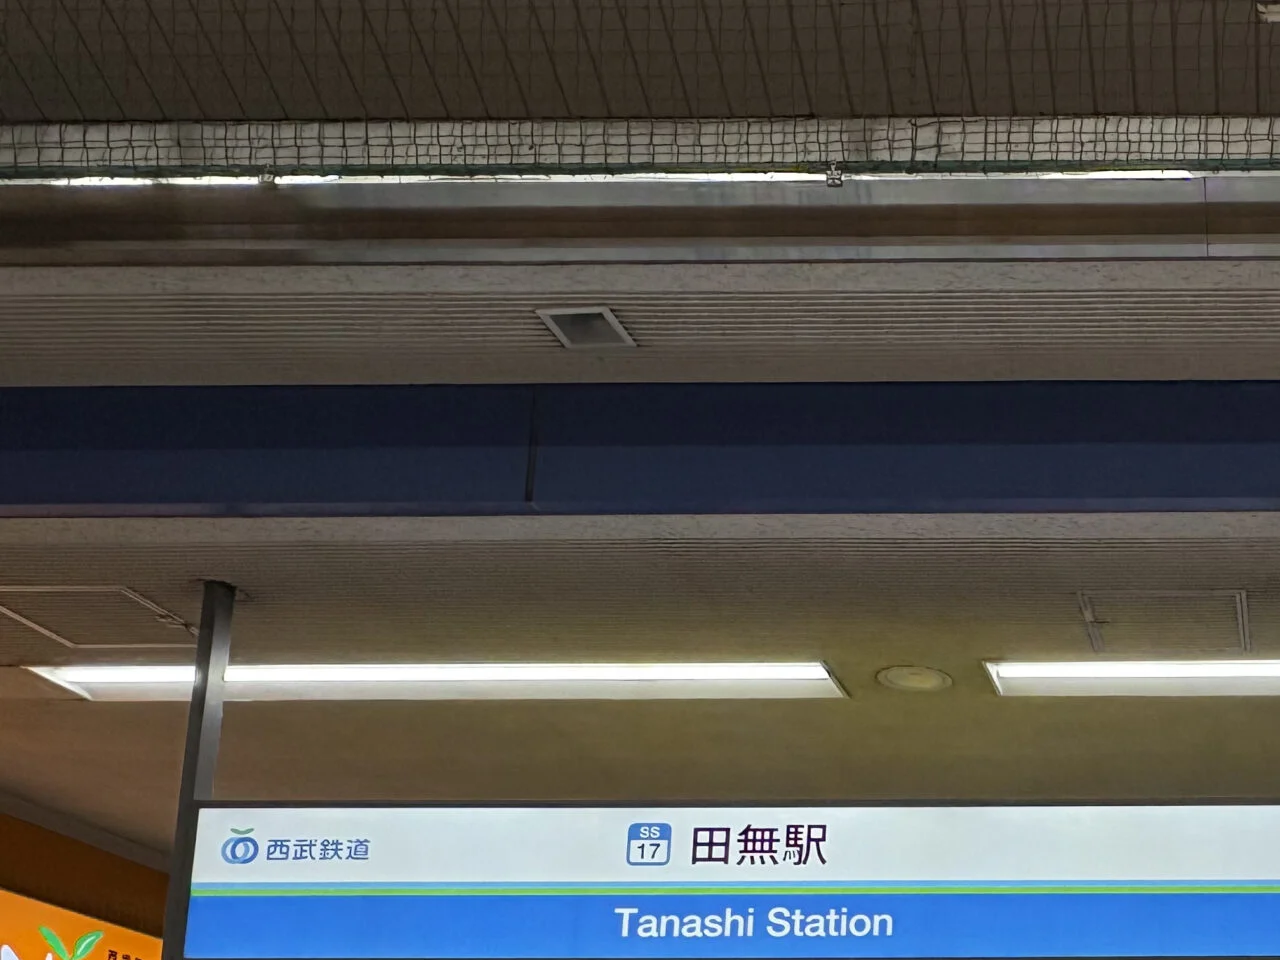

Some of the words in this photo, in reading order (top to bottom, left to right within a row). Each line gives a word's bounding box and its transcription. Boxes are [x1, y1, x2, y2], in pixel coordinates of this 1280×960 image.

[640, 826, 661, 839] SS
[266, 838, 371, 861] 西武鉄道
[637, 843, 661, 860] 17
[691, 824, 828, 866] 田無駅
[614, 907, 754, 937] Tanashi
[766, 907, 893, 937] Station
